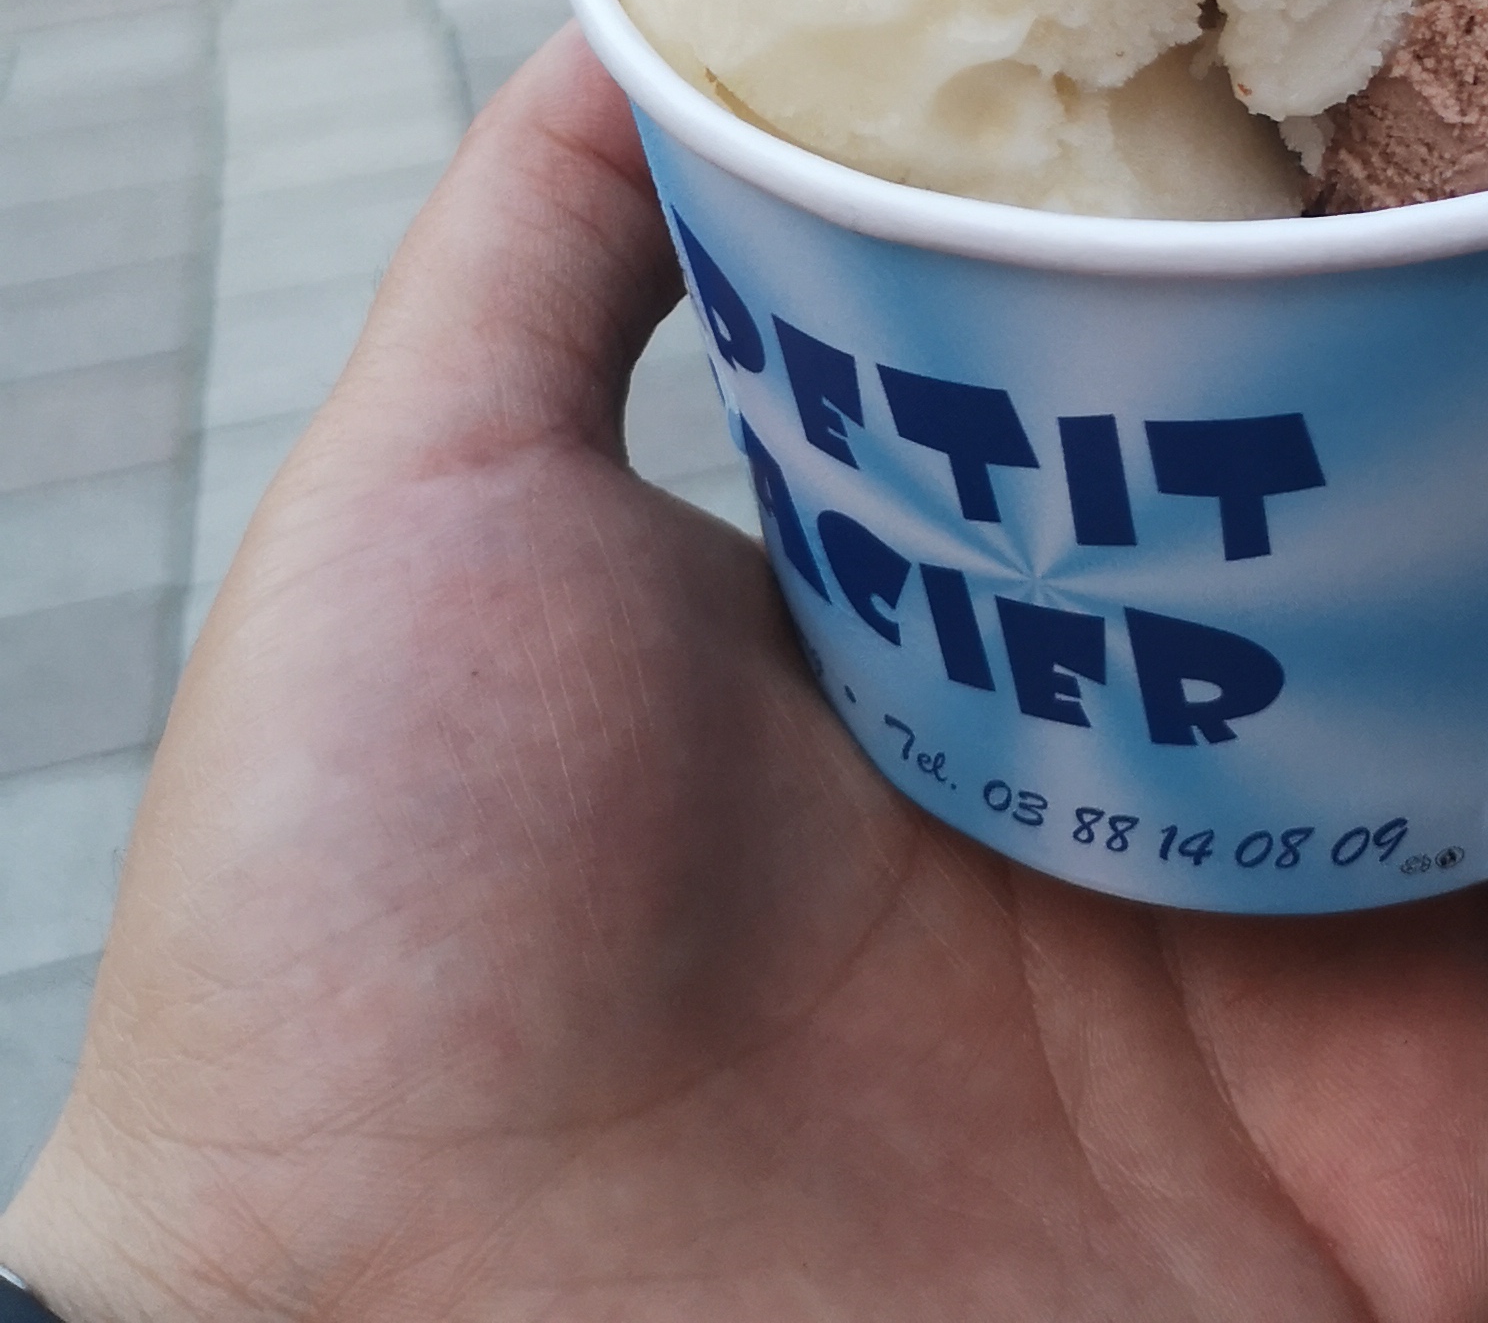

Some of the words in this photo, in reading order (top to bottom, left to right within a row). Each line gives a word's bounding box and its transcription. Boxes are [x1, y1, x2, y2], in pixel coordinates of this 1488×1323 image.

[670, 204, 1327, 562] PETIT
[740, 410, 1286, 746] ACIER
[983, 779, 1048, 826] 03
[1072, 806, 1140, 853] 88
[1158, 824, 1215, 867] 14
[1234, 825, 1317, 869] 08
[1329, 816, 1408, 867] 09
